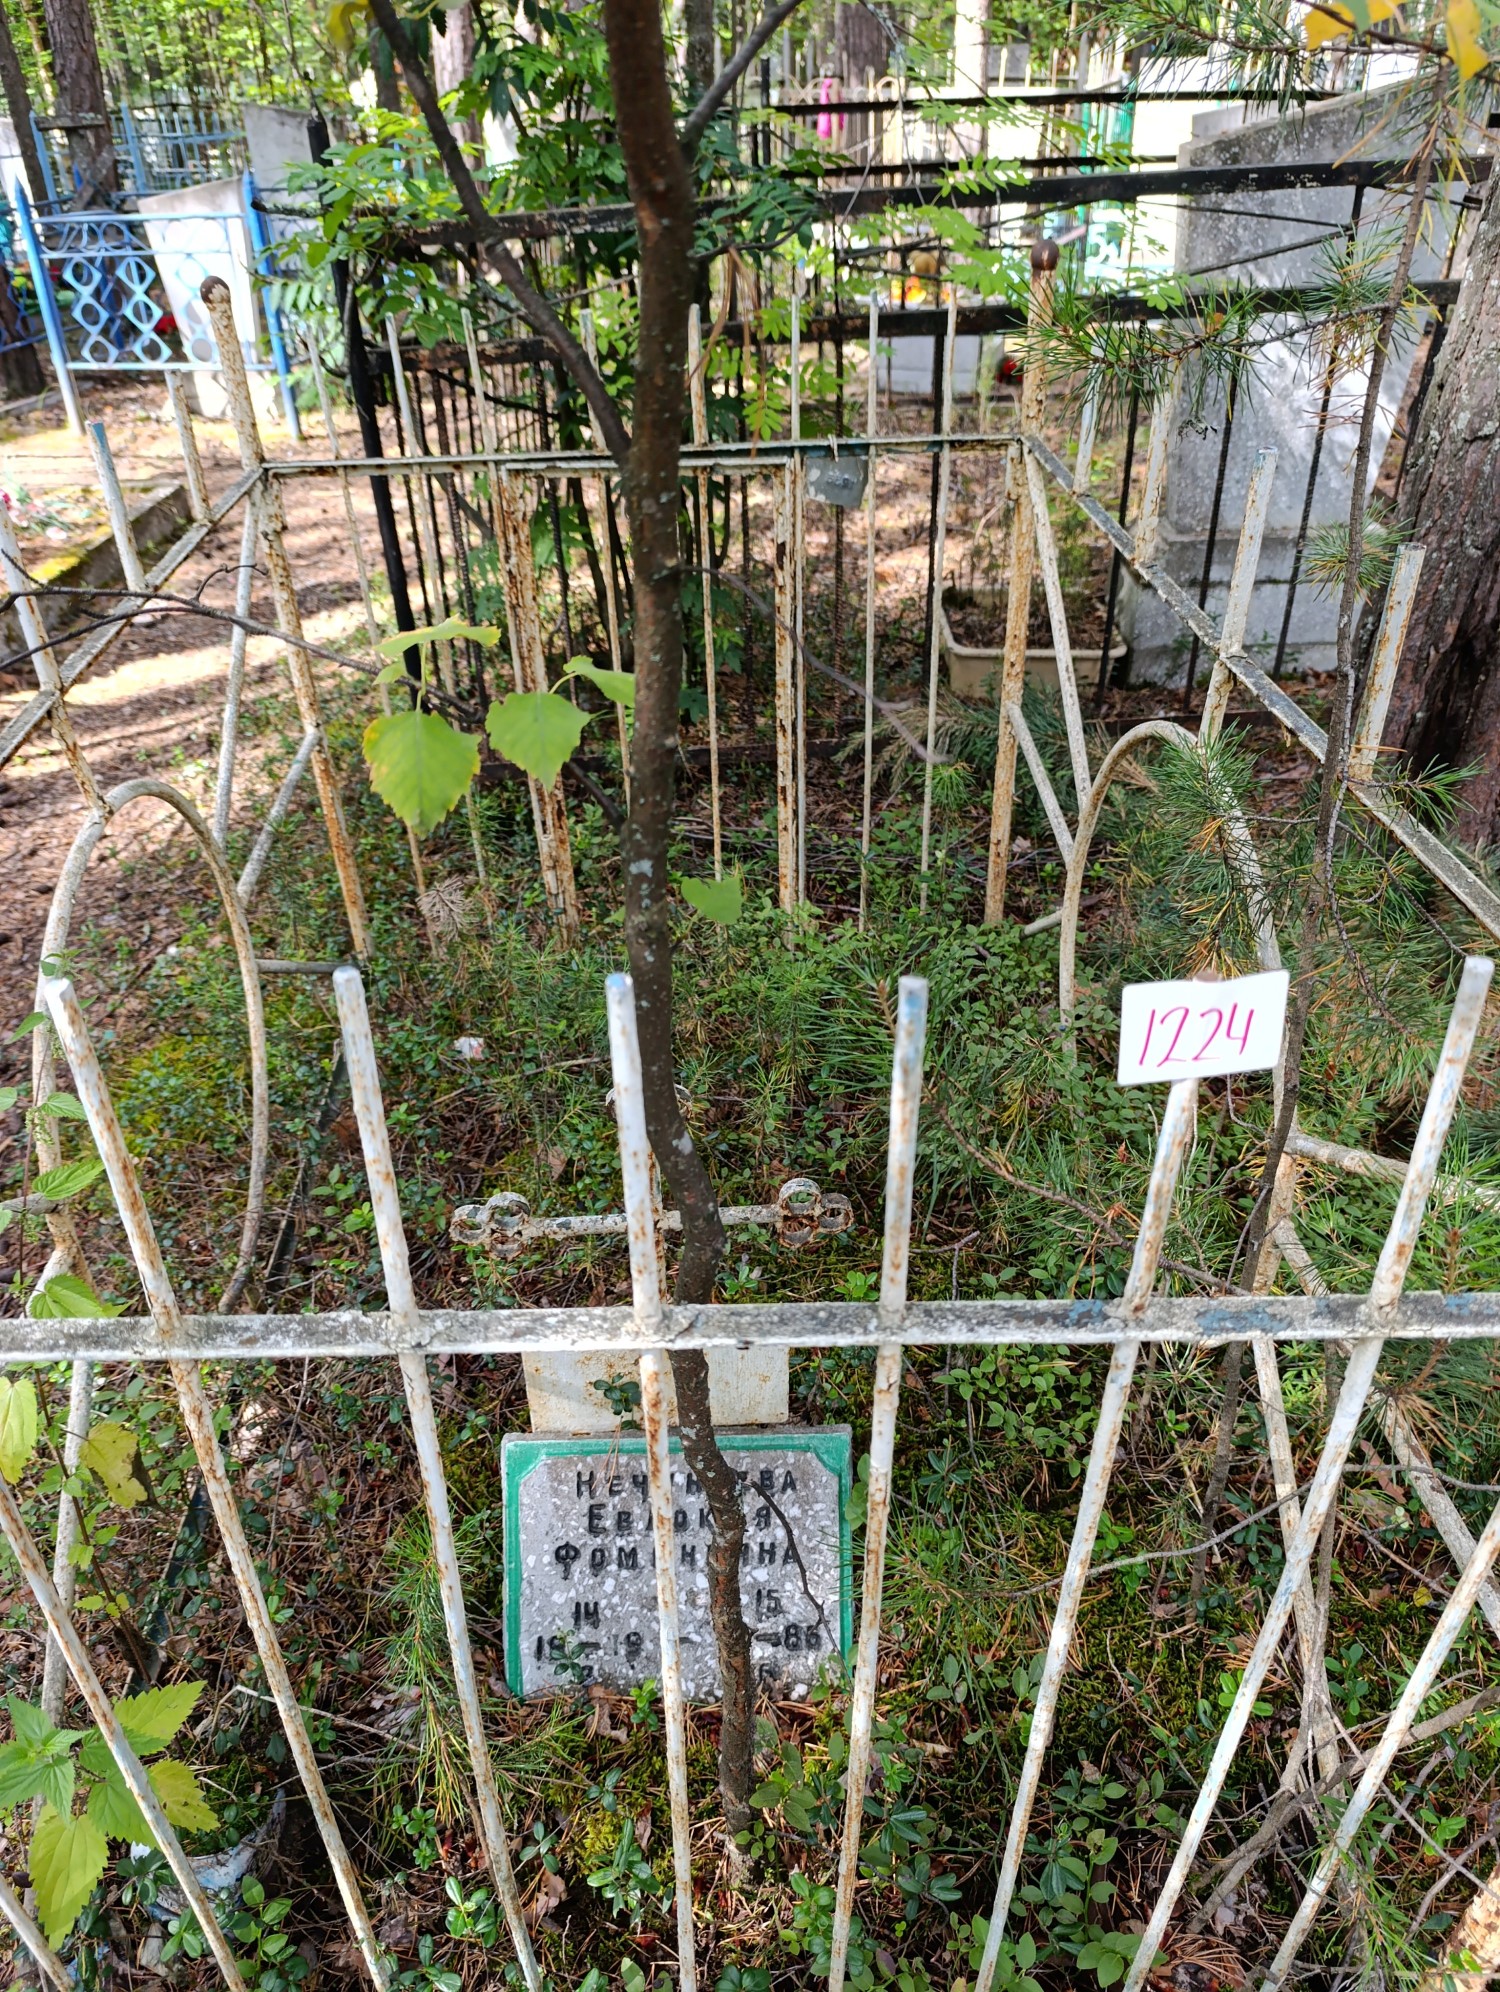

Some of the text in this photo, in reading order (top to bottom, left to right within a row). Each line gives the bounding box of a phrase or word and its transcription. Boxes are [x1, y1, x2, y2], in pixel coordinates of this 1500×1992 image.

[1139, 1002, 1254, 1067] 1224
[588, 1503, 772, 1534] ЕВОКЯ
[555, 1541, 798, 1579] ФОМННА
[574, 1601, 600, 1630] 14
